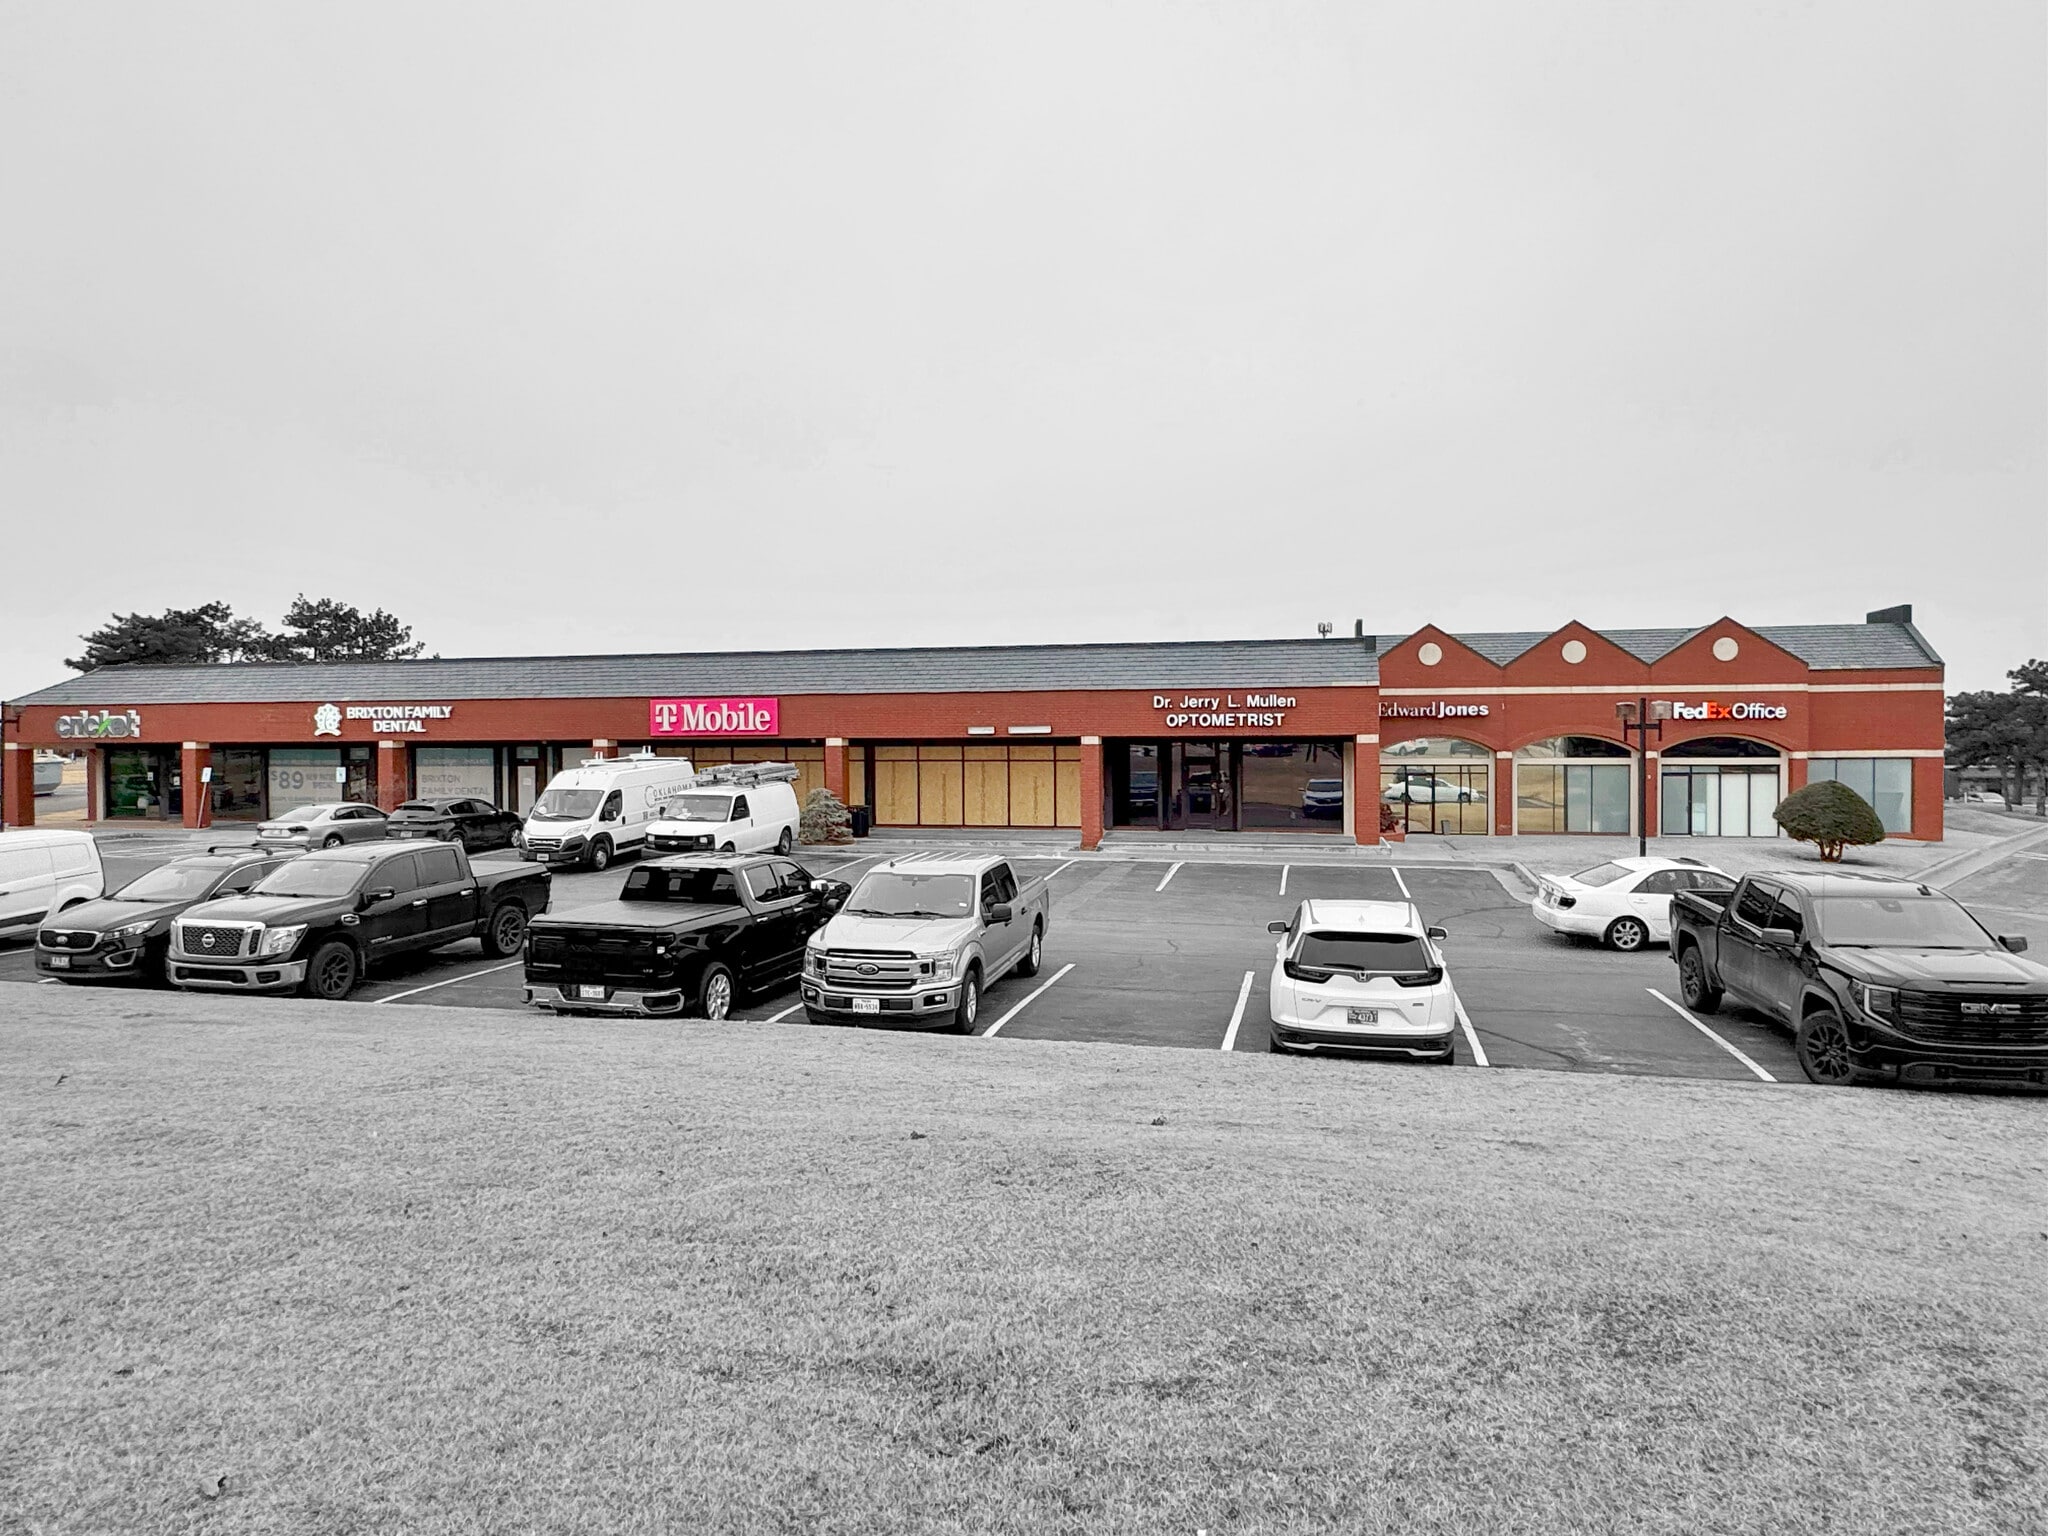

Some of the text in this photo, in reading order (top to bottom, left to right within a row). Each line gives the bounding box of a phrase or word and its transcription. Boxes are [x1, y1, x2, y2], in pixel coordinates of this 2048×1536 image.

[1153, 694, 1296, 711] Dr. Jerry L. Mullen
[346, 706, 453, 719] BRIXTON FAMILY
[1378, 701, 1490, 718] Edward Jones
[1673, 701, 1788, 720] FedEx Office
[680, 703, 771, 732] Mobile
[1166, 713, 1286, 727] OPTOMETRIST
[372, 720, 427, 733] DENTAL
[421, 774, 461, 784] BRIXTON
[421, 786, 491, 796] FAMILY DENTAL
[1960, 1002, 2021, 1015] GMC
